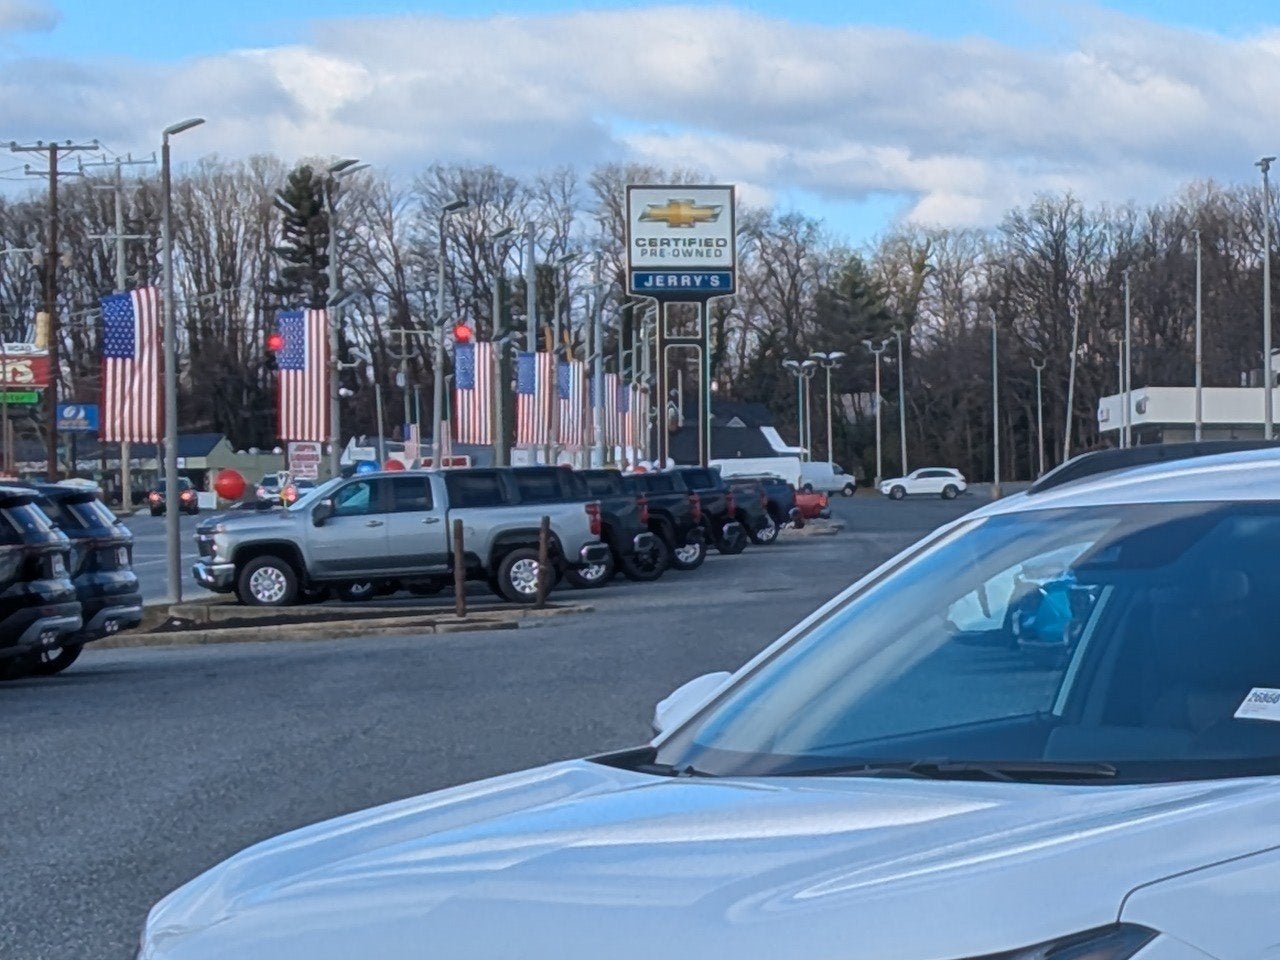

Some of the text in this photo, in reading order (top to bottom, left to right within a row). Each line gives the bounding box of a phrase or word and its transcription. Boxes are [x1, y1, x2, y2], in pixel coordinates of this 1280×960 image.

[635, 237, 728, 248] CERTIFIED
[640, 248, 723, 258] PRE-OWNED
[643, 275, 720, 287] JERRY'S
